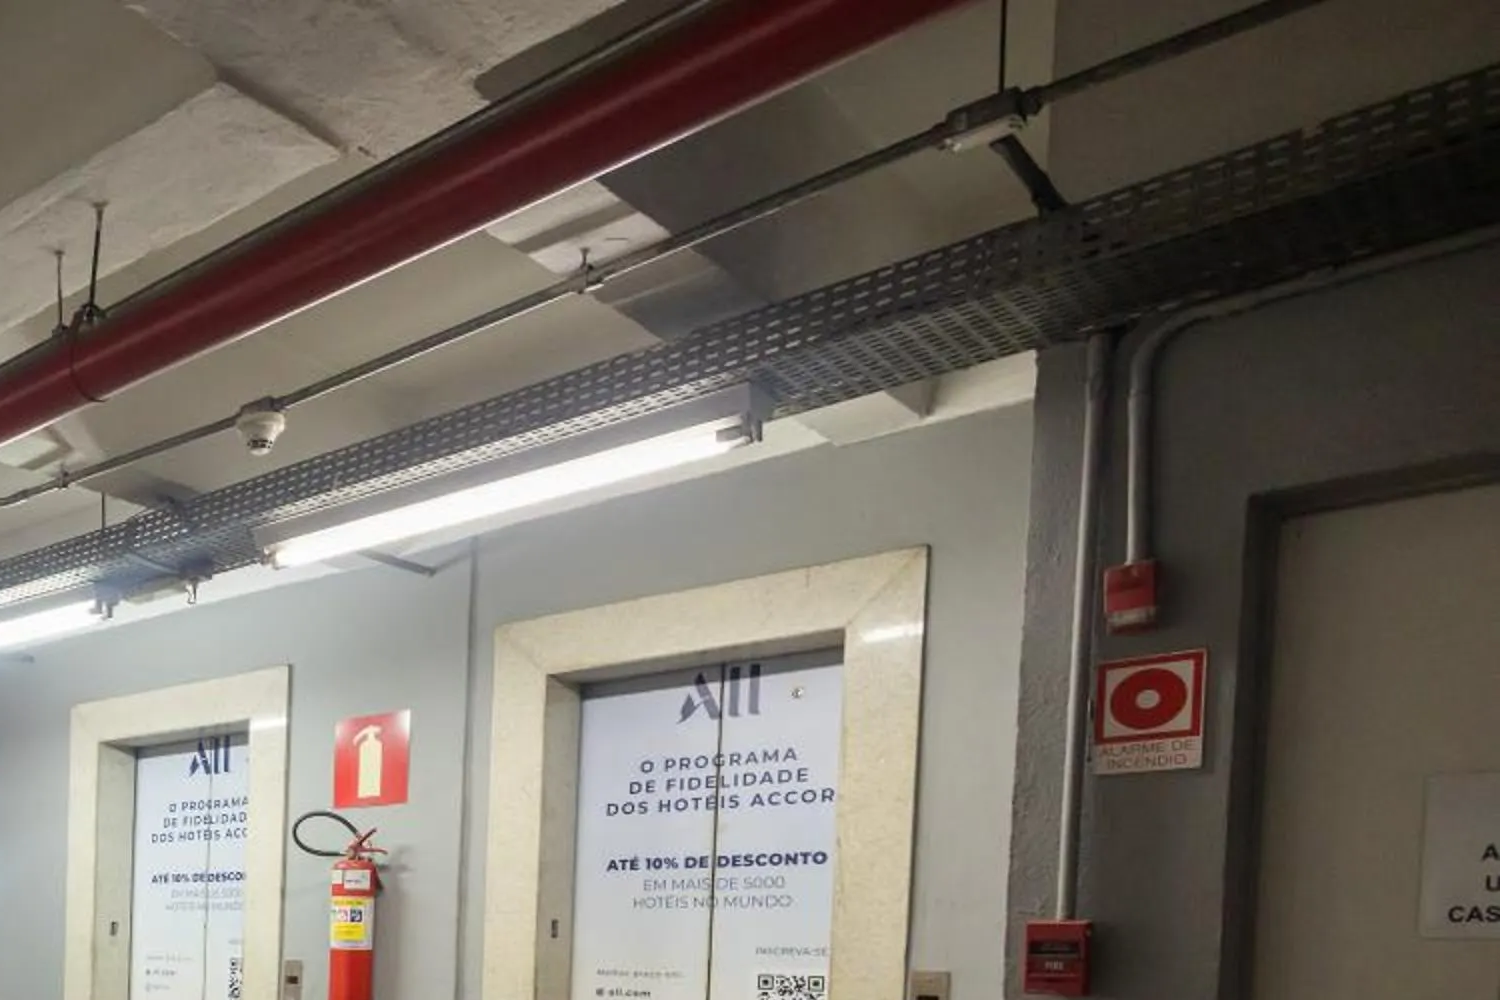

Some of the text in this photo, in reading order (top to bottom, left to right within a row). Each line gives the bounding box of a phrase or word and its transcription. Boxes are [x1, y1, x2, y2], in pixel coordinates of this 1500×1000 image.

[1171, 739, 1195, 752] DE
[640, 747, 799, 774] O PROGRAMA
[629, 767, 810, 796] DE FIDELIDADE
[169, 803, 177, 813] O
[605, 801, 649, 817] DOS
[750, 787, 836, 807] ACCOR
[163, 811, 248, 829] DE FIDELIDAD
[151, 831, 174, 844] DOS
[605, 850, 829, 871] ATÉ 10% DE DESCONTO
[643, 878, 667, 892] EM
[671, 877, 711, 891] MAIS
[717, 877, 738, 891] DE
[693, 894, 718, 909] NO
[723, 893, 793, 909] MUNDO
